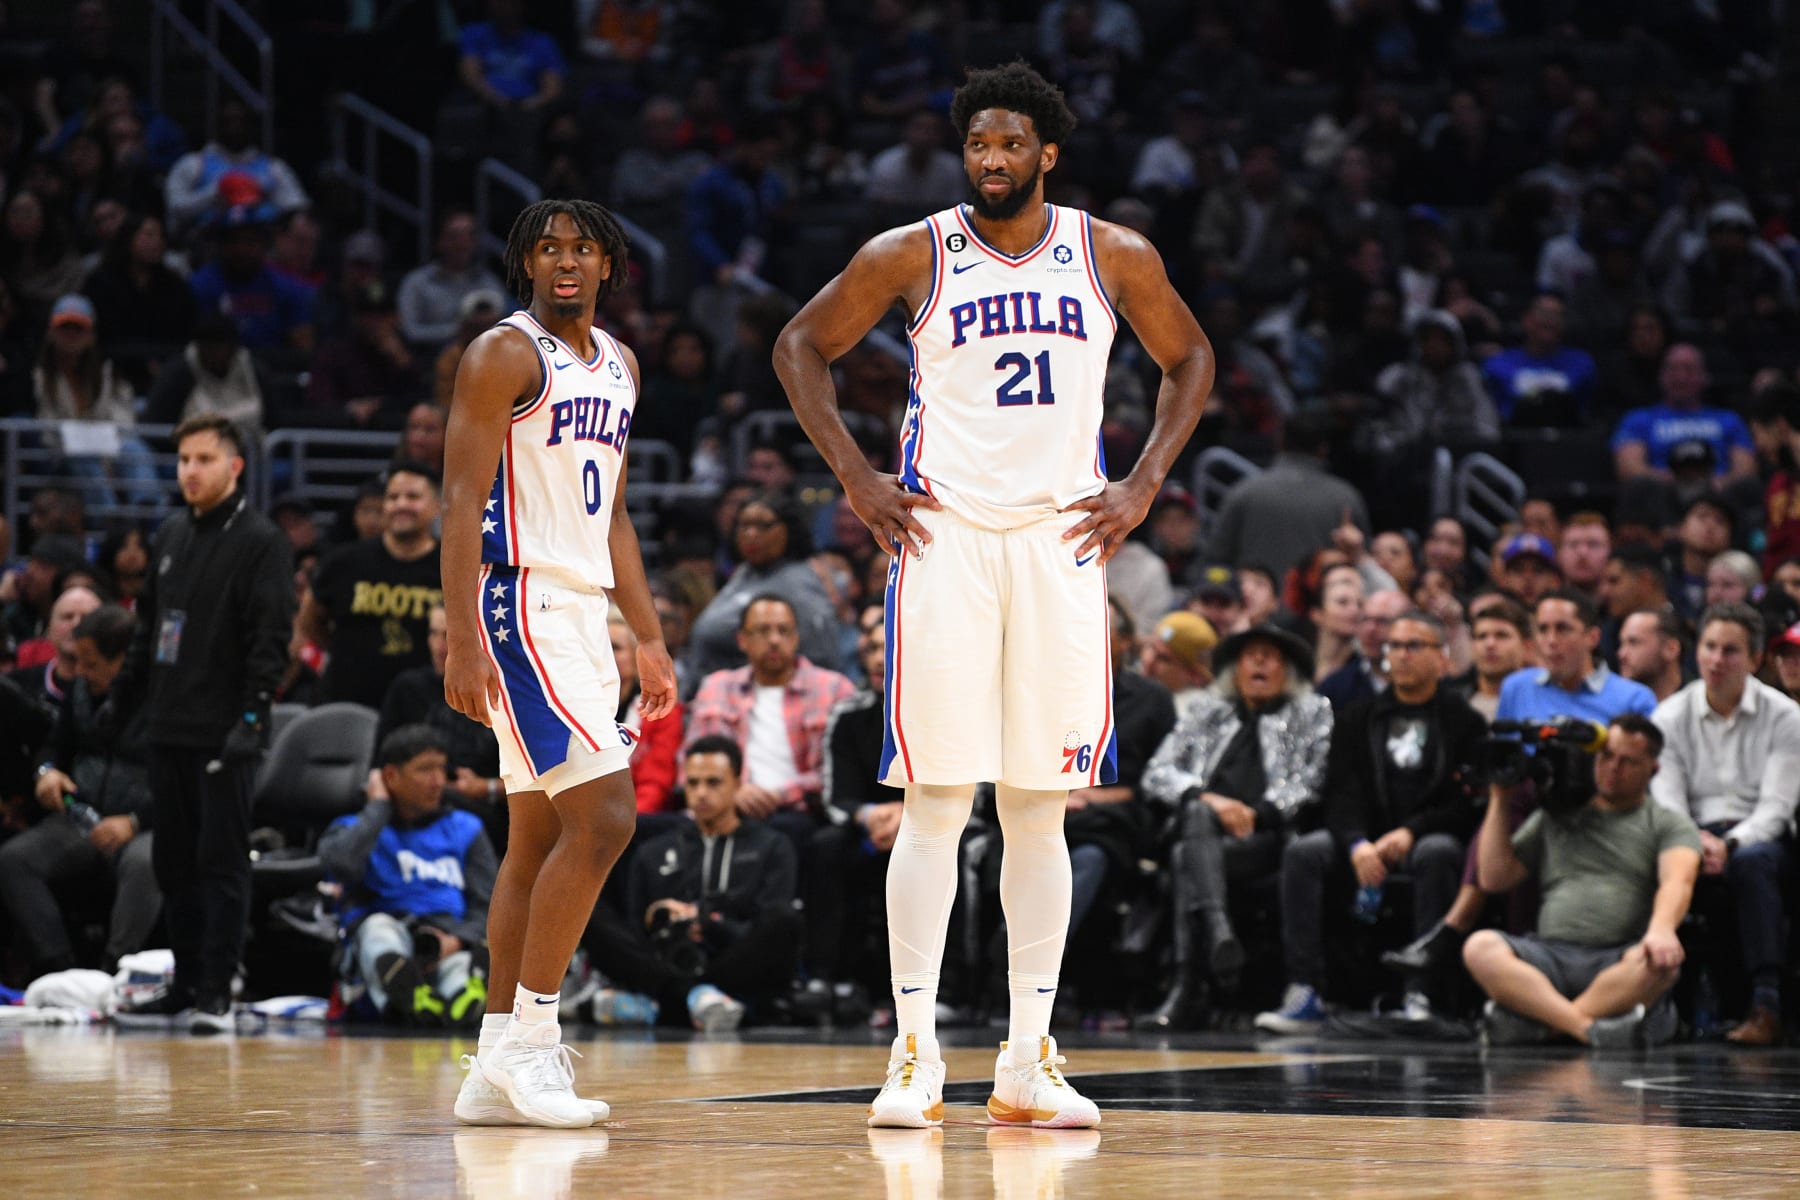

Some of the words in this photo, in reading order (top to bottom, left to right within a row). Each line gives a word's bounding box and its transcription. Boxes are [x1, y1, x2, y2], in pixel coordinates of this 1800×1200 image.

[950, 236, 963, 251] 6
[949, 291, 1088, 349] PHILA
[994, 350, 1055, 407] 21
[546, 396, 631, 457] PHILA
[582, 459, 602, 516] 0
[1061, 744, 1092, 774] 76
